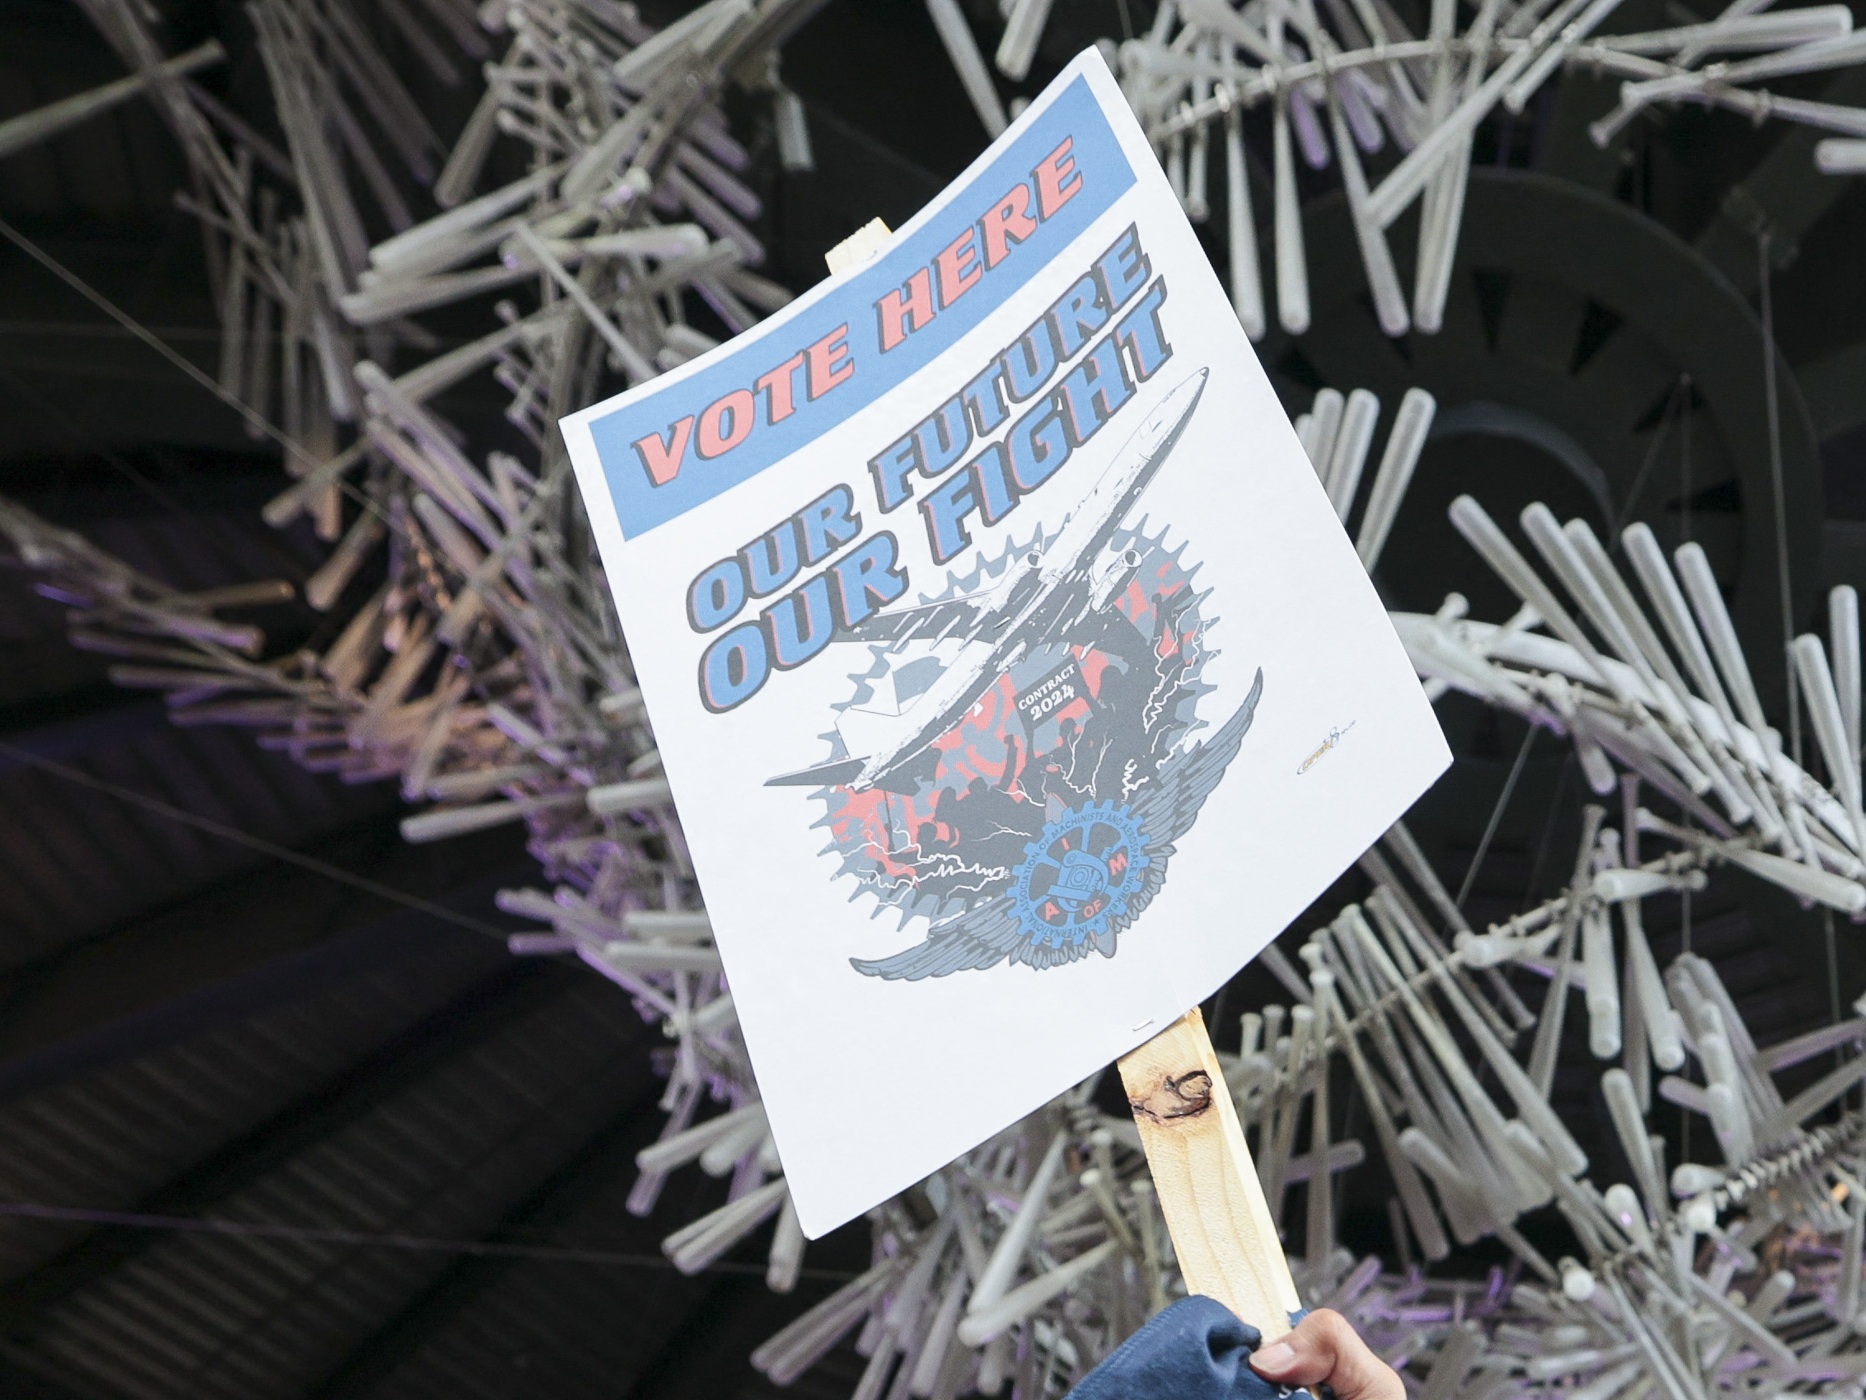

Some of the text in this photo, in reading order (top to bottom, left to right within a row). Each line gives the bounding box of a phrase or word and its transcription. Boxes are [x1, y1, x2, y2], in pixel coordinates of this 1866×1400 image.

[630, 135, 1083, 487] VOTE HERE
[686, 221, 1152, 634] OUR FUTURE
[698, 274, 1174, 713] OUR FIGHT
[1018, 663, 1075, 710] CONTRACT
[1030, 684, 1075, 721] 2024
[1019, 852, 1041, 912] ASSOCIATION
[1039, 836, 1050, 850] OF
[1051, 811, 1105, 839] MACHINISTS
[1106, 813, 1123, 826] AND
[1120, 823, 1139, 871] AEROSPACE
[1108, 852, 1128, 876] M
[1045, 899, 1102, 921] A OF
